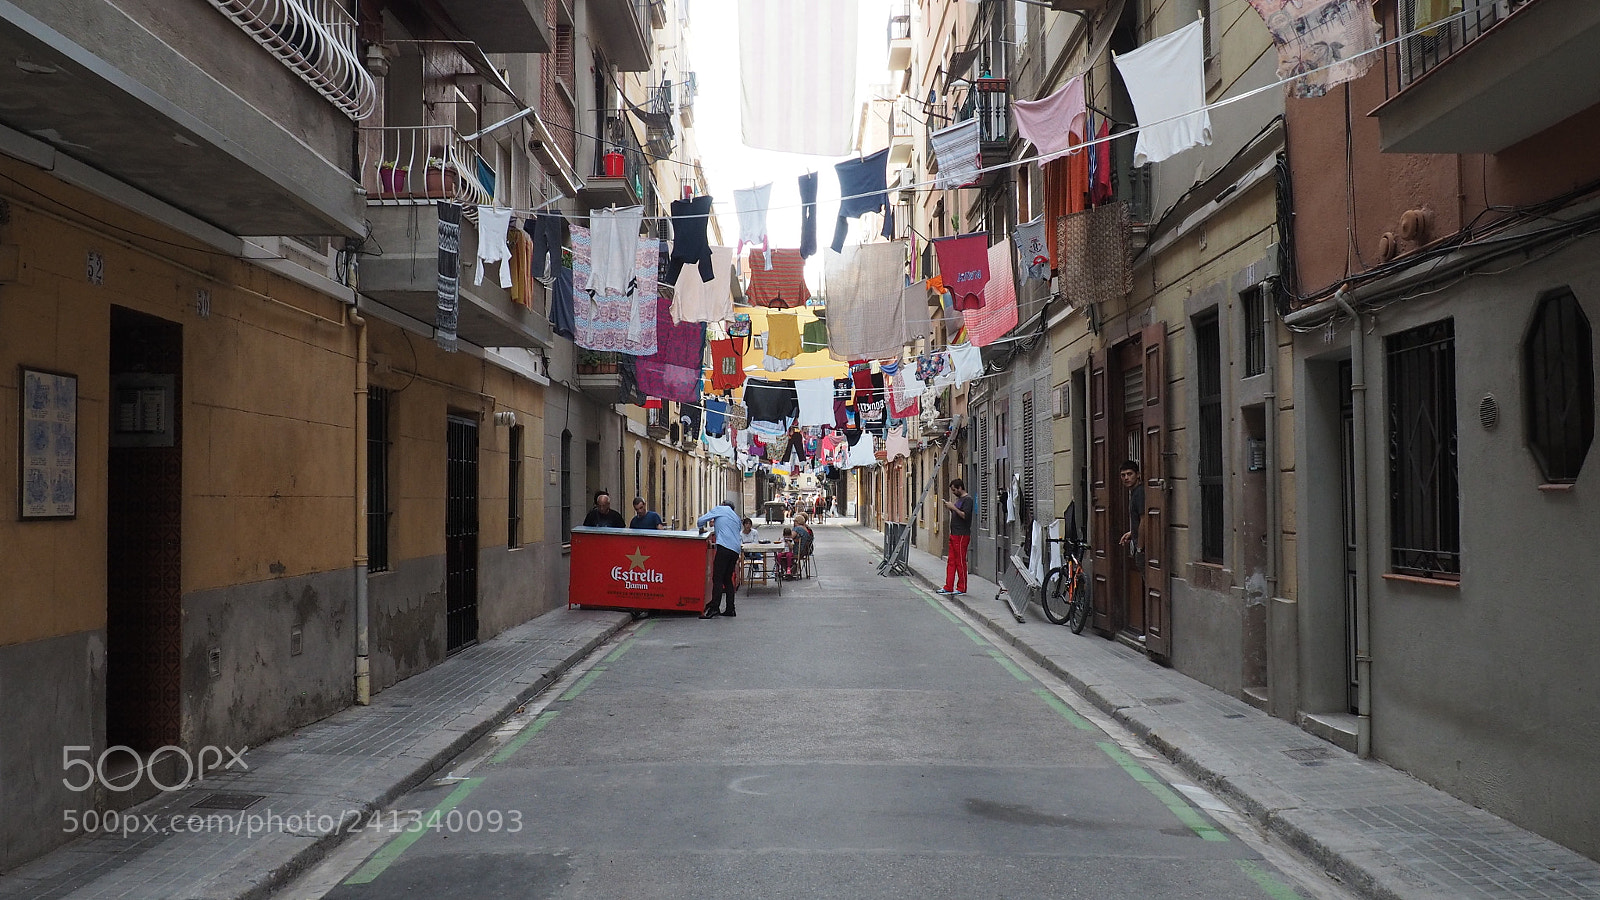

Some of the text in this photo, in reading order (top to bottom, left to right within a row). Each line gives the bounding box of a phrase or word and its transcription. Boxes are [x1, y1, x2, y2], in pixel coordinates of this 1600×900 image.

[88, 254, 102, 280] 52
[611, 565, 663, 583] Estrella
[625, 581, 648, 590] Damm
